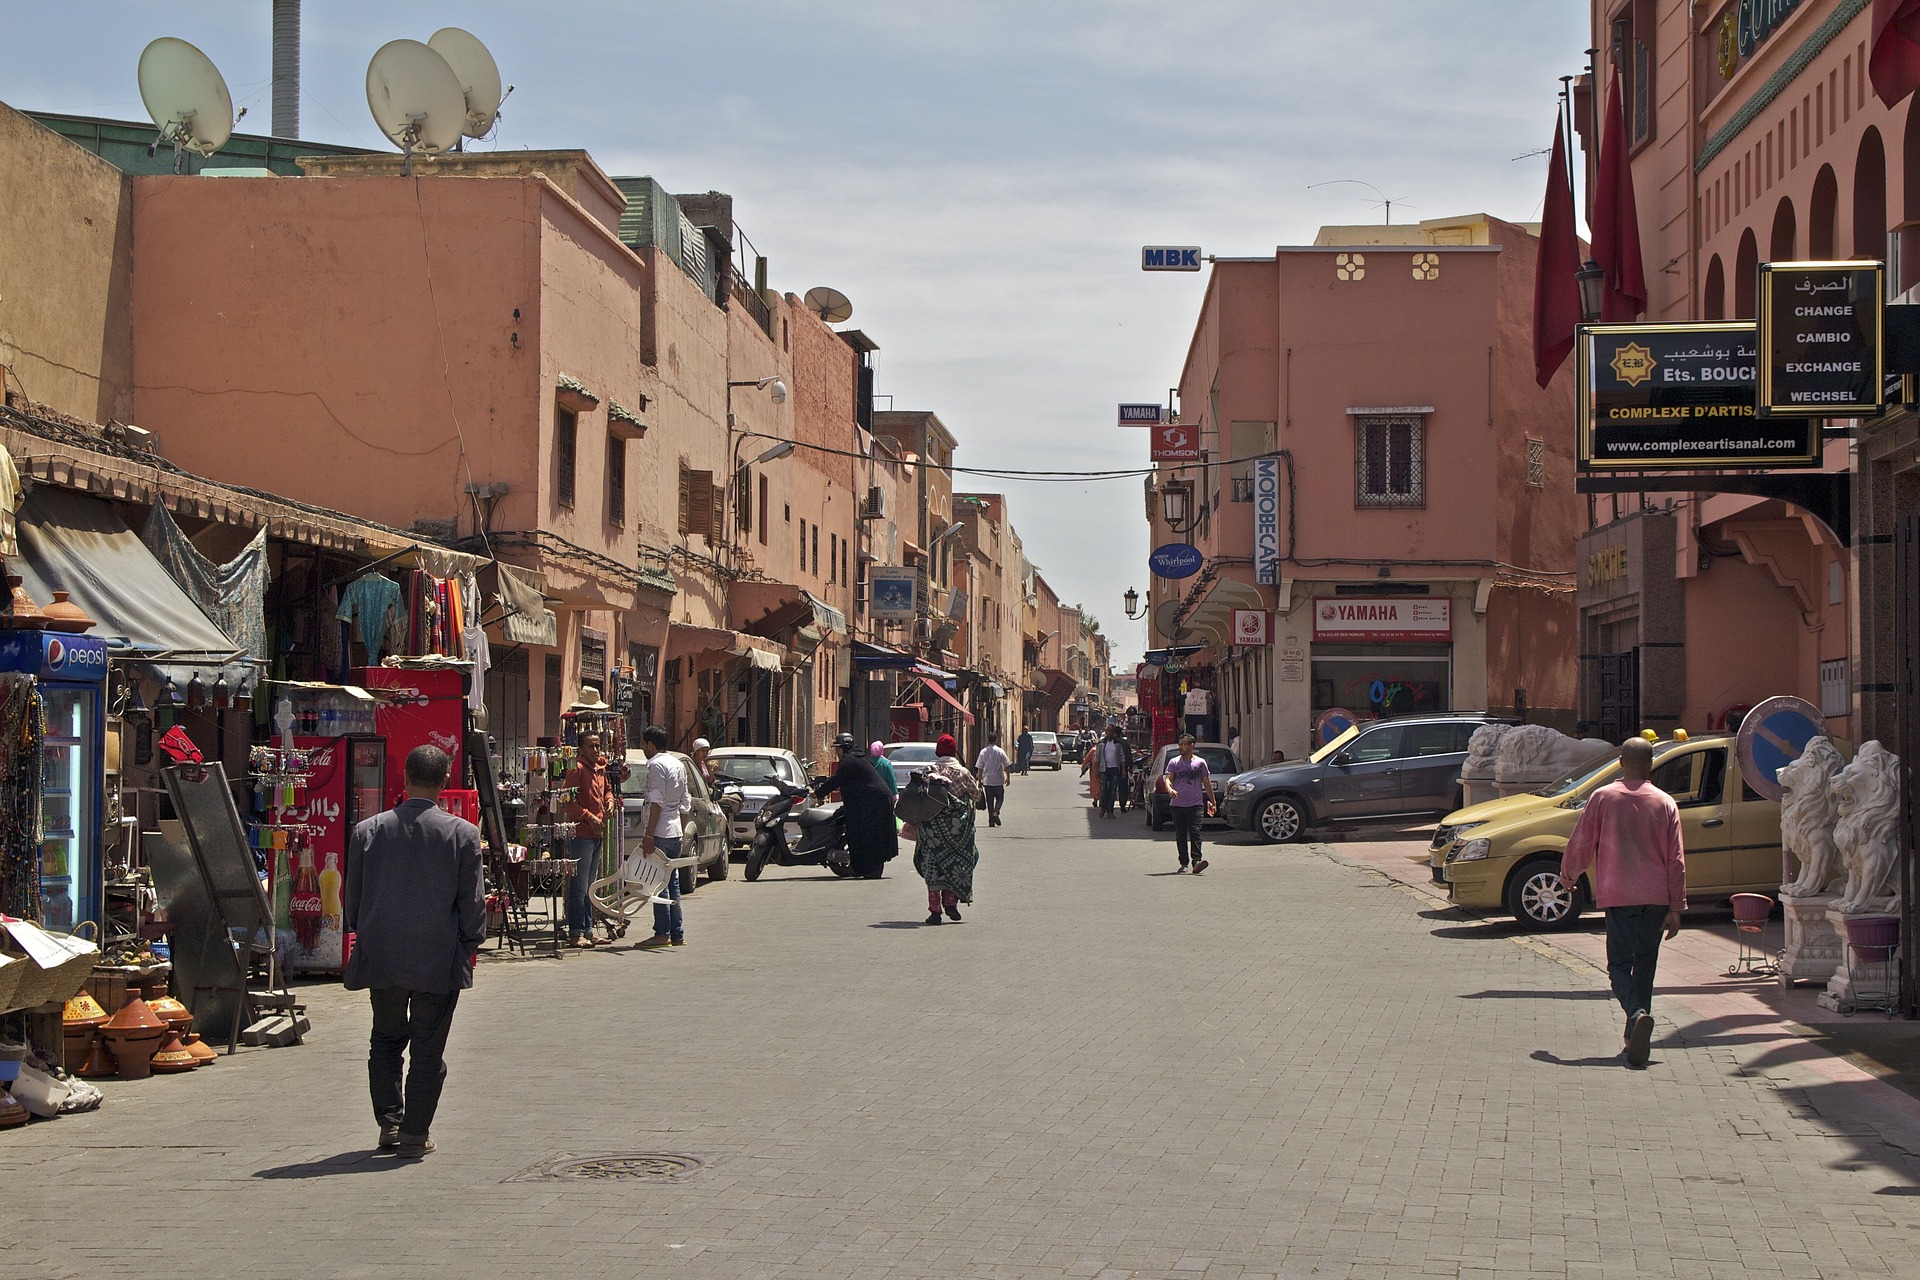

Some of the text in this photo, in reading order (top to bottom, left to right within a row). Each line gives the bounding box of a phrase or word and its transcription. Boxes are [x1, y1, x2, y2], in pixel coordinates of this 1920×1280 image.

[1145, 249, 1198, 266] MBK
[1794, 276, 1852, 296] الصرف
[1794, 306, 1853, 316] CHANGE
[1796, 333, 1851, 342] CAMBIO
[1785, 362, 1862, 372] EXCHANGE
[1663, 368, 1696, 381] Ets.
[1790, 391, 1857, 402] WECHSEL
[1123, 407, 1157, 419] YAMAHA
[1609, 405, 1757, 419] COMPLEXE D'ARTIS
[1607, 438, 1796, 453] www.complexeartisanal.com
[1153, 449, 1198, 457] THOMSON
[1258, 460, 1276, 584] MOTOBECANE
[1157, 555, 1196, 566] Whirlpool
[1588, 544, 1628, 587] SORTIE
[1338, 605, 1398, 620] YAMAHA
[69, 647, 104, 668] pepsi
